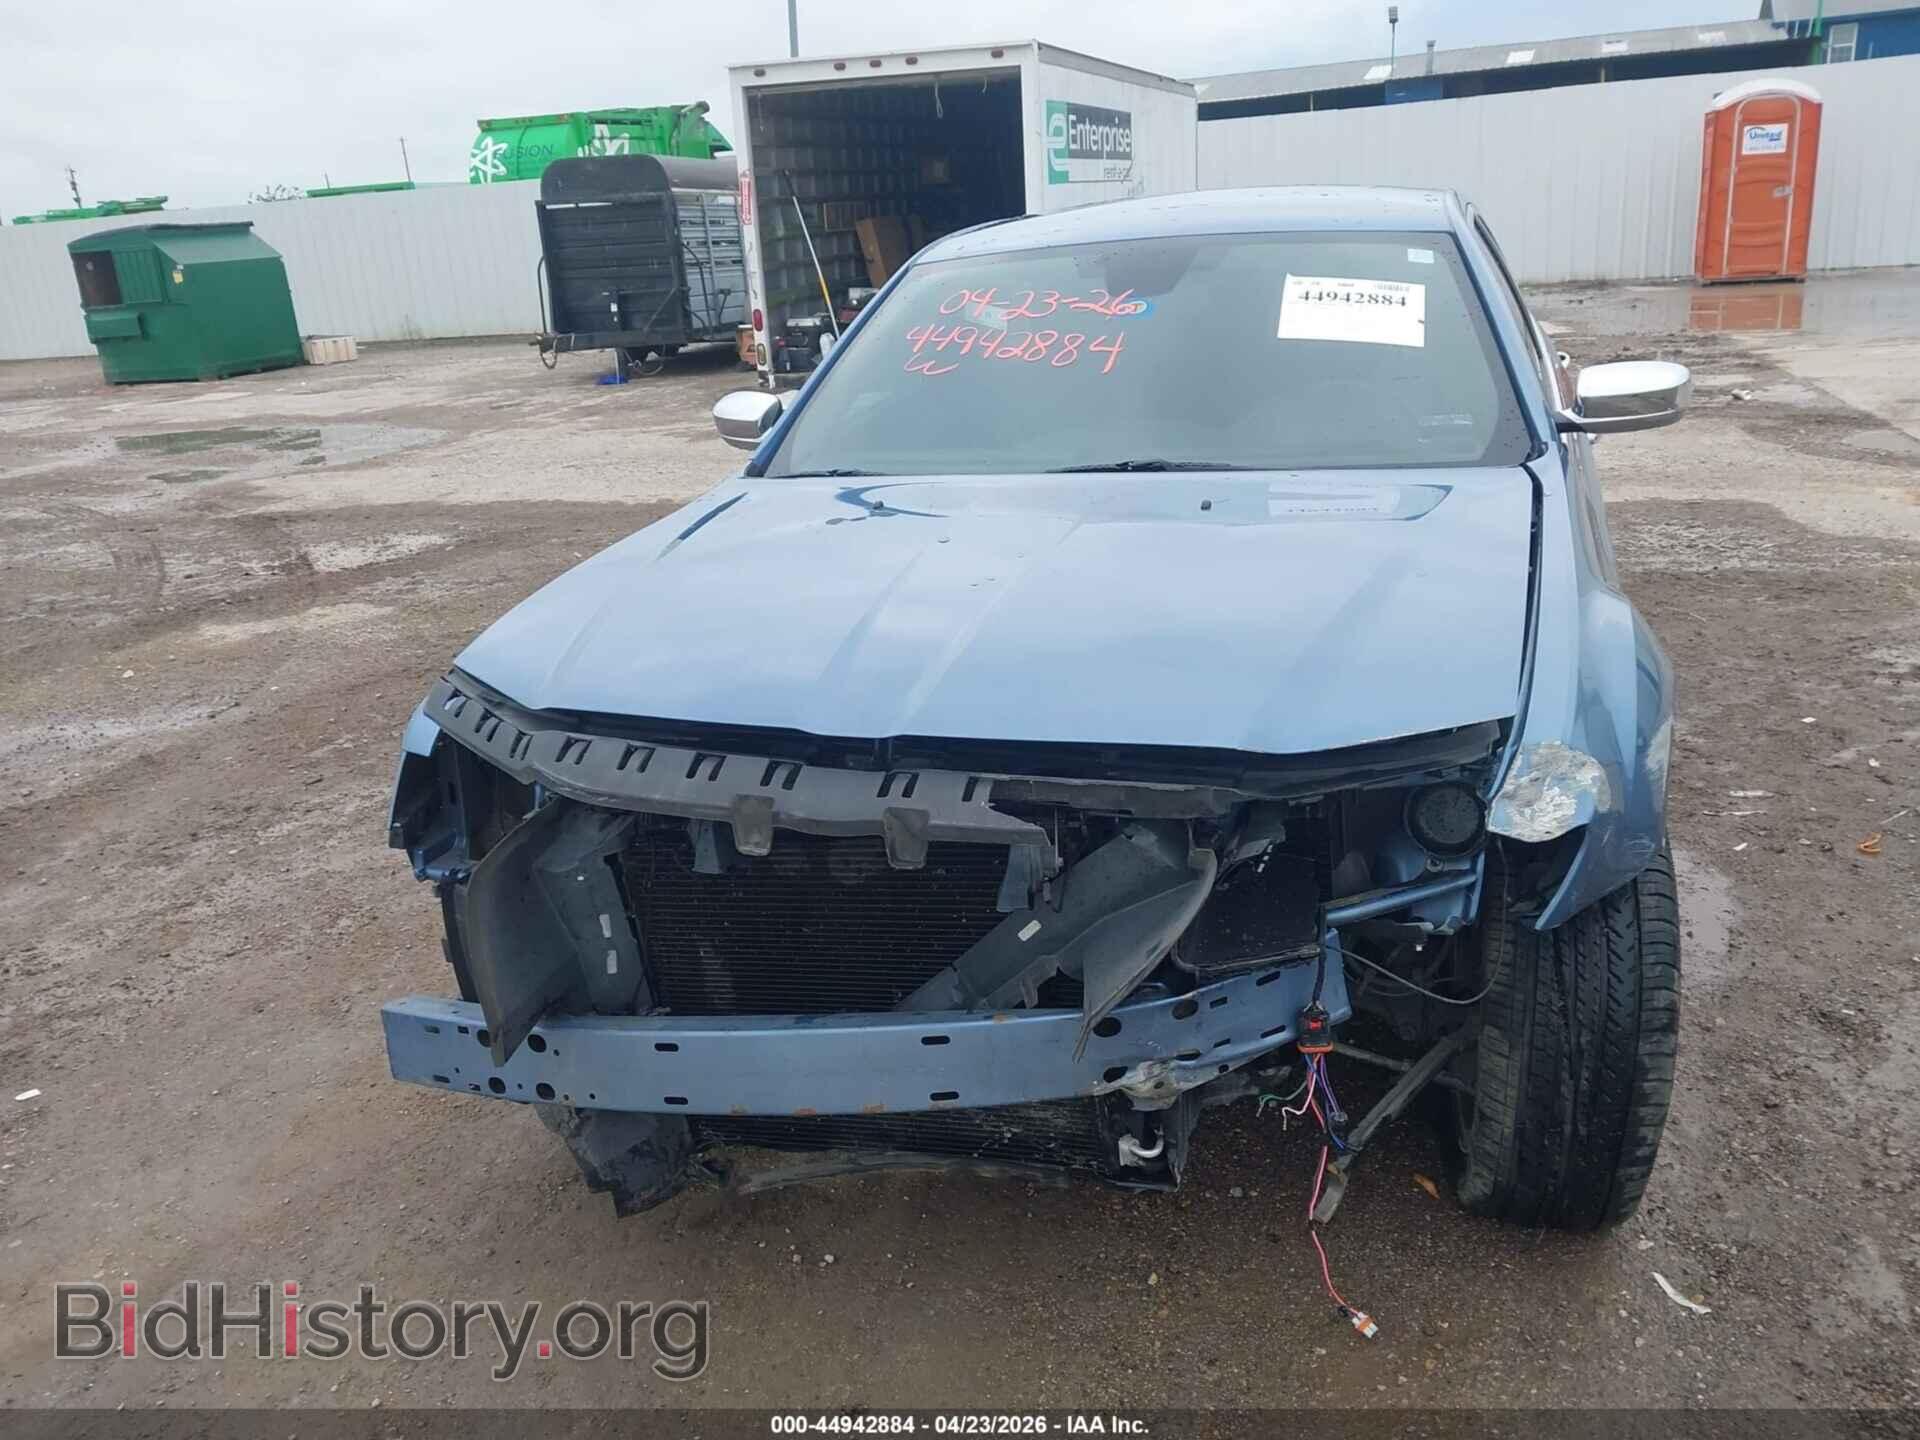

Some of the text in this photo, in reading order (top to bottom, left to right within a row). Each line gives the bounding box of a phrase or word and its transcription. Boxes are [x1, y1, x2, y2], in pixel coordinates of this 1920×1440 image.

[1068, 114, 1131, 160] Enterprise
[1298, 290, 1407, 307] 44942884
[906, 322, 1125, 374] 44942884
